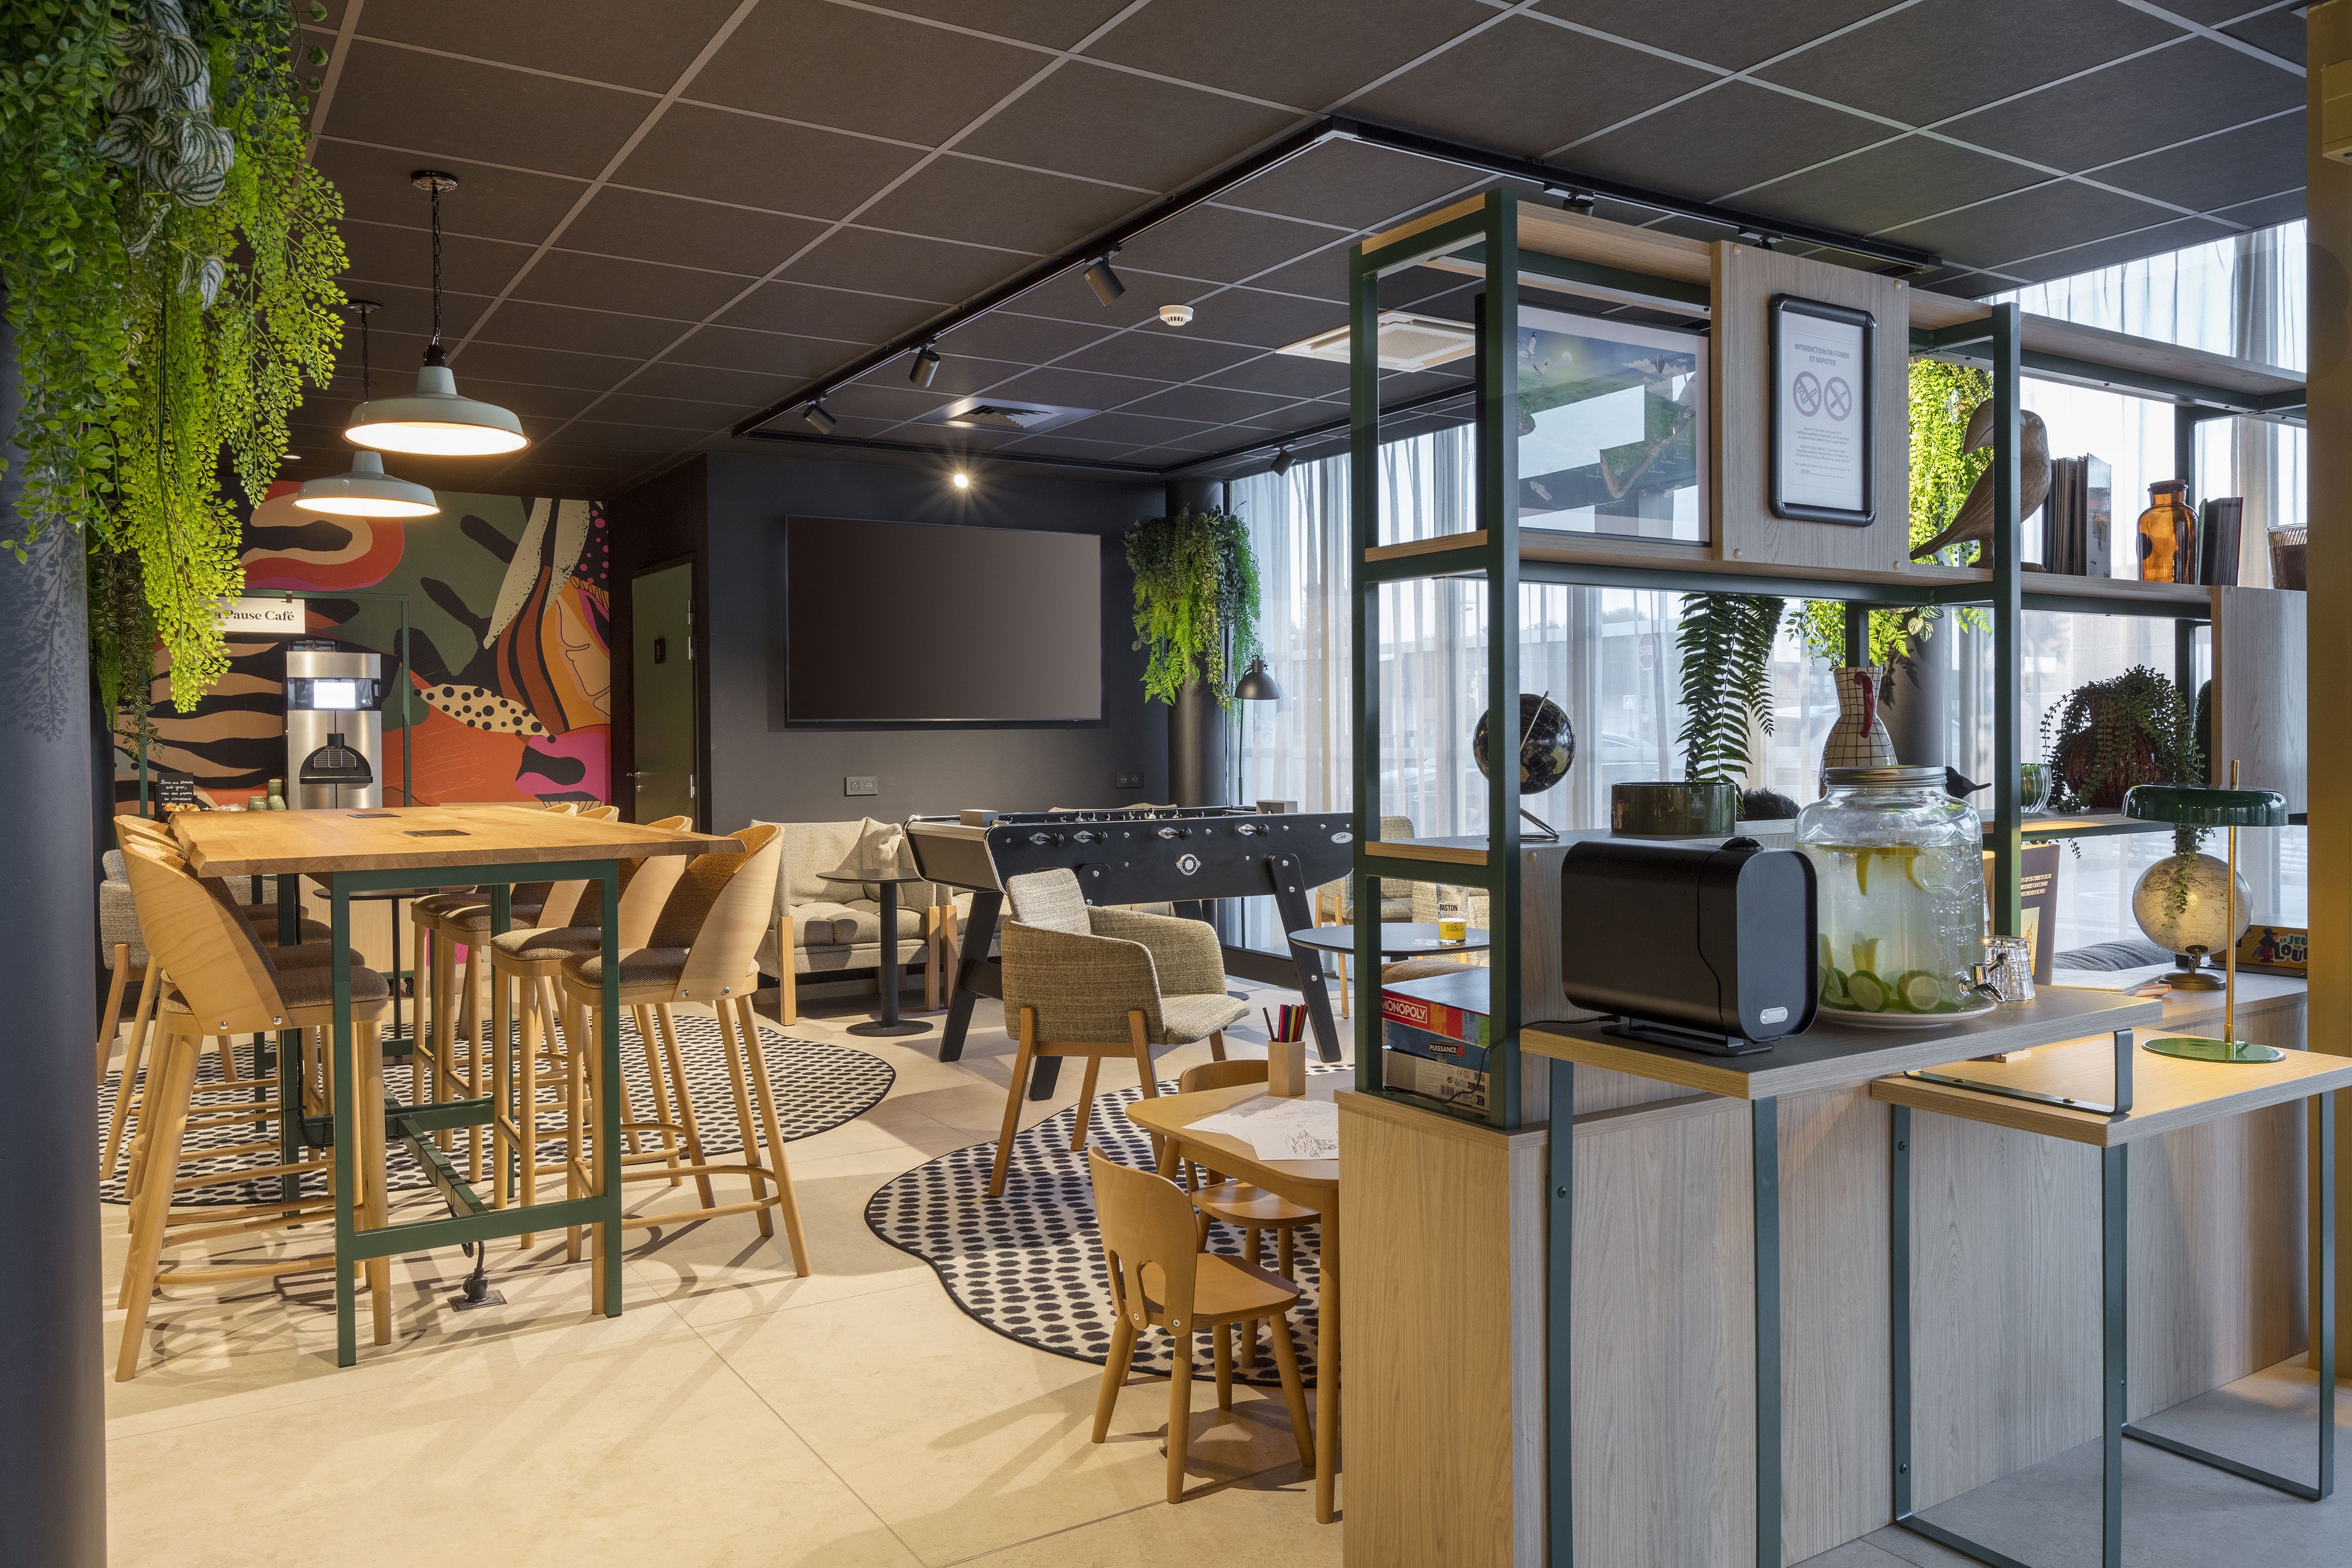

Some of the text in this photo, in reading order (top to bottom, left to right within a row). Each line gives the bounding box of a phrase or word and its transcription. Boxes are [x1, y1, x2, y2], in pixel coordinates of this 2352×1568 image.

[1795, 344, 1826, 355] INTERDICTION
[1834, 350, 1850, 359] FUMER
[1815, 357, 1836, 366] VAPOTER
[265, 611, 294, 621] Café
[2288, 935, 2307, 946] JEU
[2273, 941, 2307, 962] LOU
[1382, 999, 1426, 1020] MONOPOLY
[1429, 1042, 1464, 1058] PUISSANCE 4
